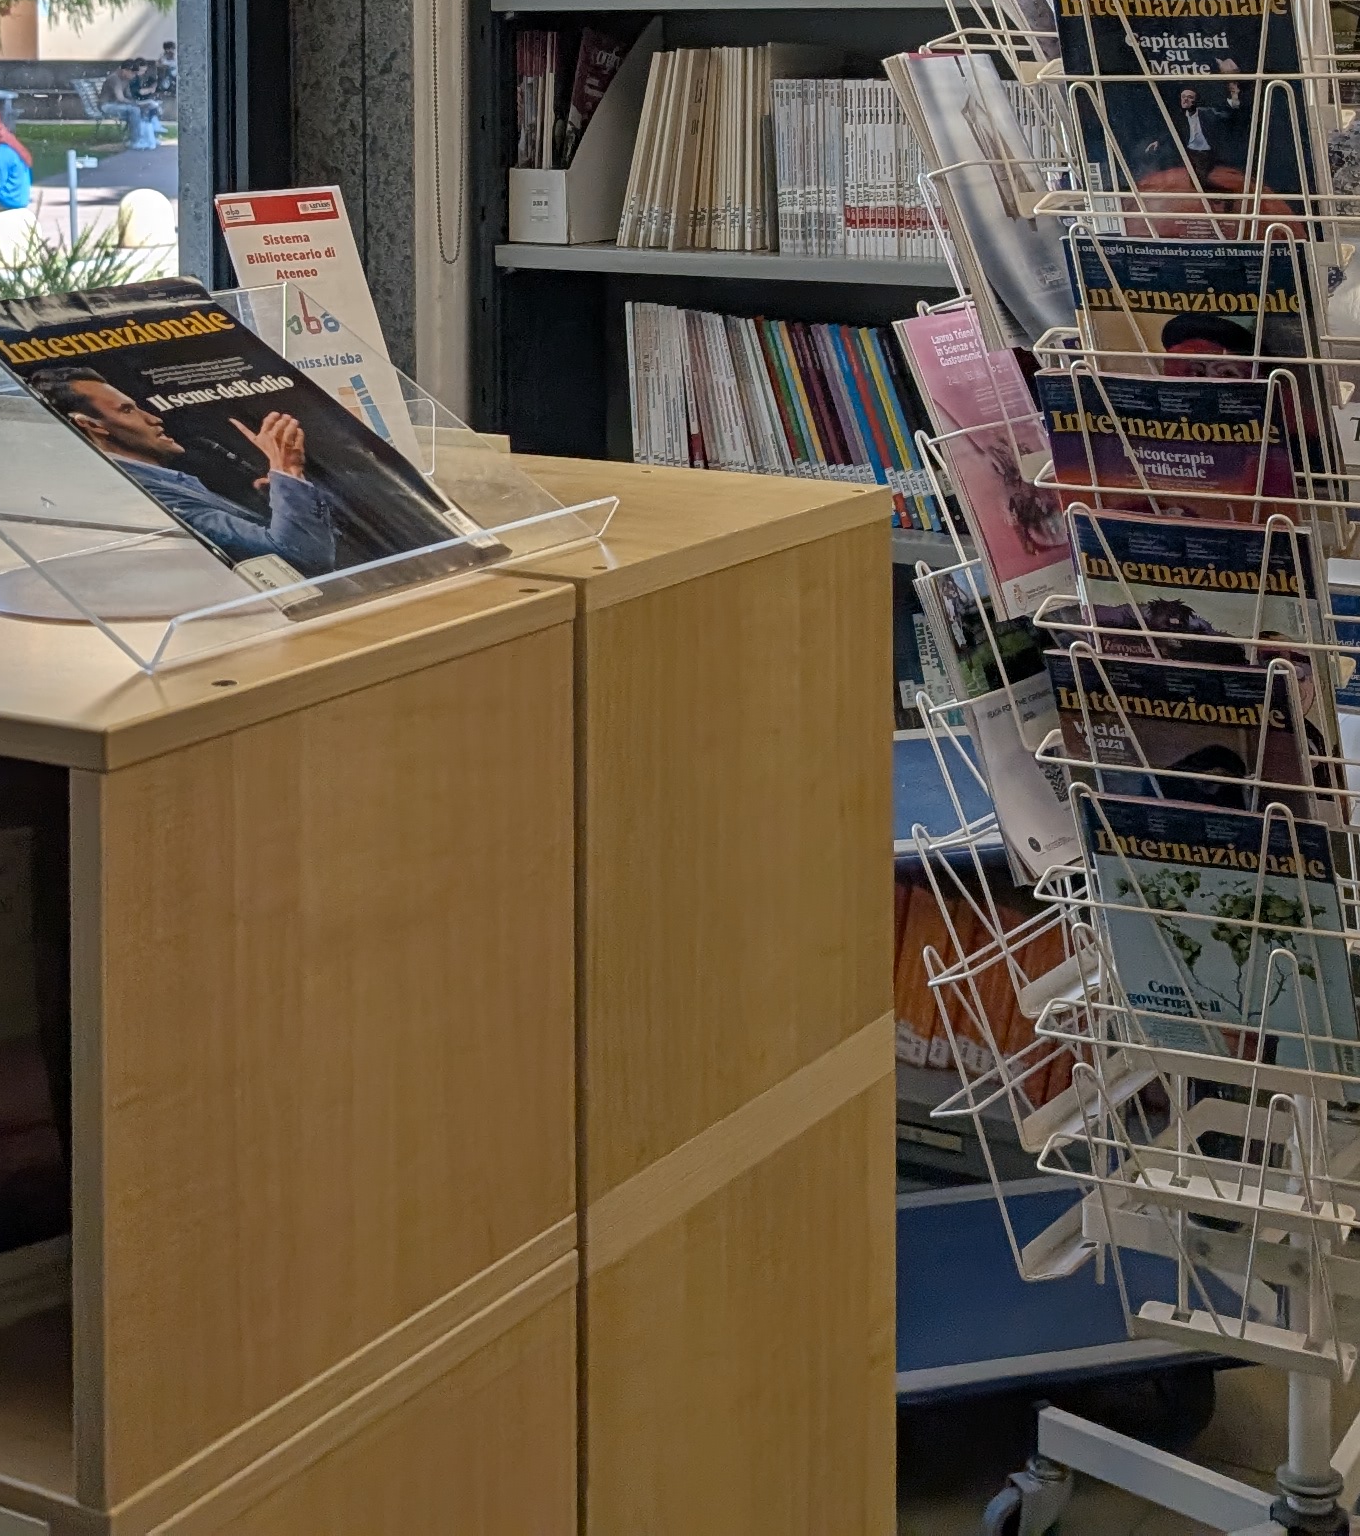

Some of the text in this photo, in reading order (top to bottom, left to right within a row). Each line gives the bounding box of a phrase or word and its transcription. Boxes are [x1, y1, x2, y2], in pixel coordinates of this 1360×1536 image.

[1125, 32, 1229, 52] Capitalisti
[1166, 50, 1190, 62] su
[1149, 61, 1211, 75] Marte
[263, 233, 310, 246] Sistema
[246, 246, 336, 265] Bibliotecario di
[1126, 245, 1134, 254] il
[1134, 246, 1189, 257] calendario
[1190, 249, 1214, 258] 2025
[1215, 248, 1226, 257] di
[276, 268, 318, 281] Ateneo
[146, 374, 295, 413] Il seme dell'odio
